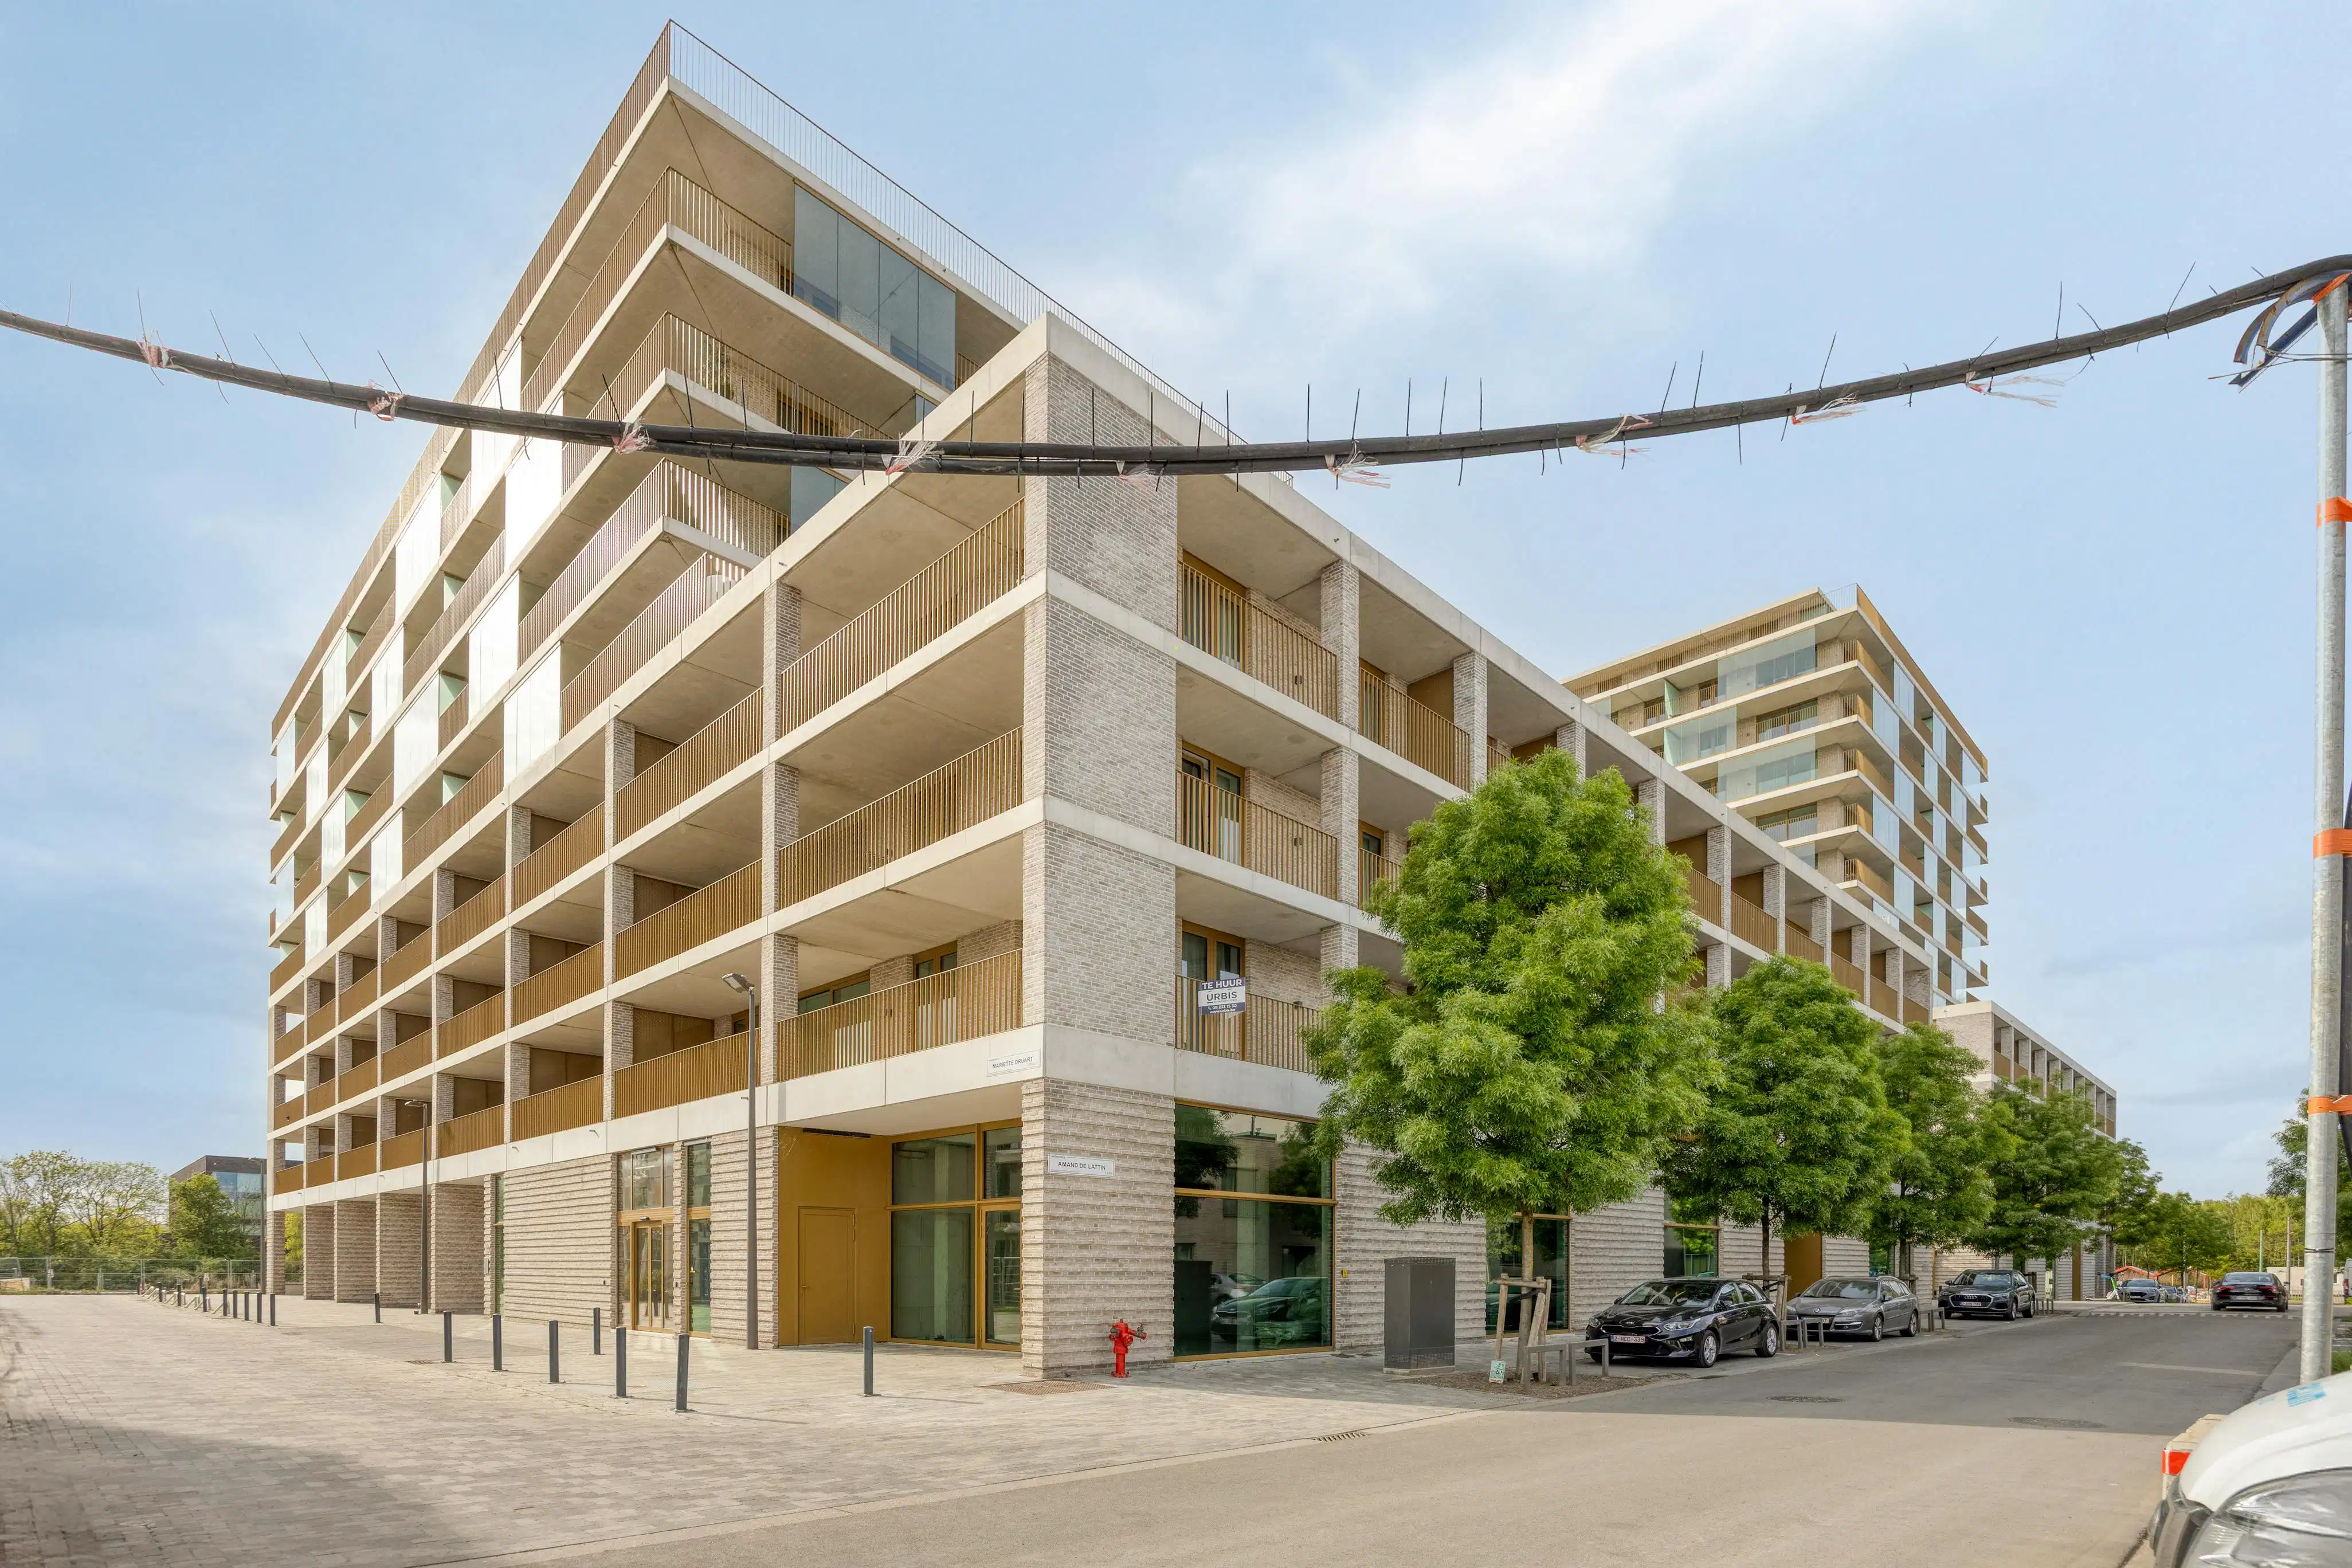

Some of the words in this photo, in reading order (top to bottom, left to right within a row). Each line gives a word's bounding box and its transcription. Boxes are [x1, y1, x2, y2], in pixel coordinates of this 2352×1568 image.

[1202, 982, 1213, 990] TE
[1216, 979, 1242, 988] HUUR
[1206, 991, 1237, 1002] URBIS
[993, 1060, 1014, 1068] MARIETTE
[1015, 1056, 1033, 1065] DRUART
